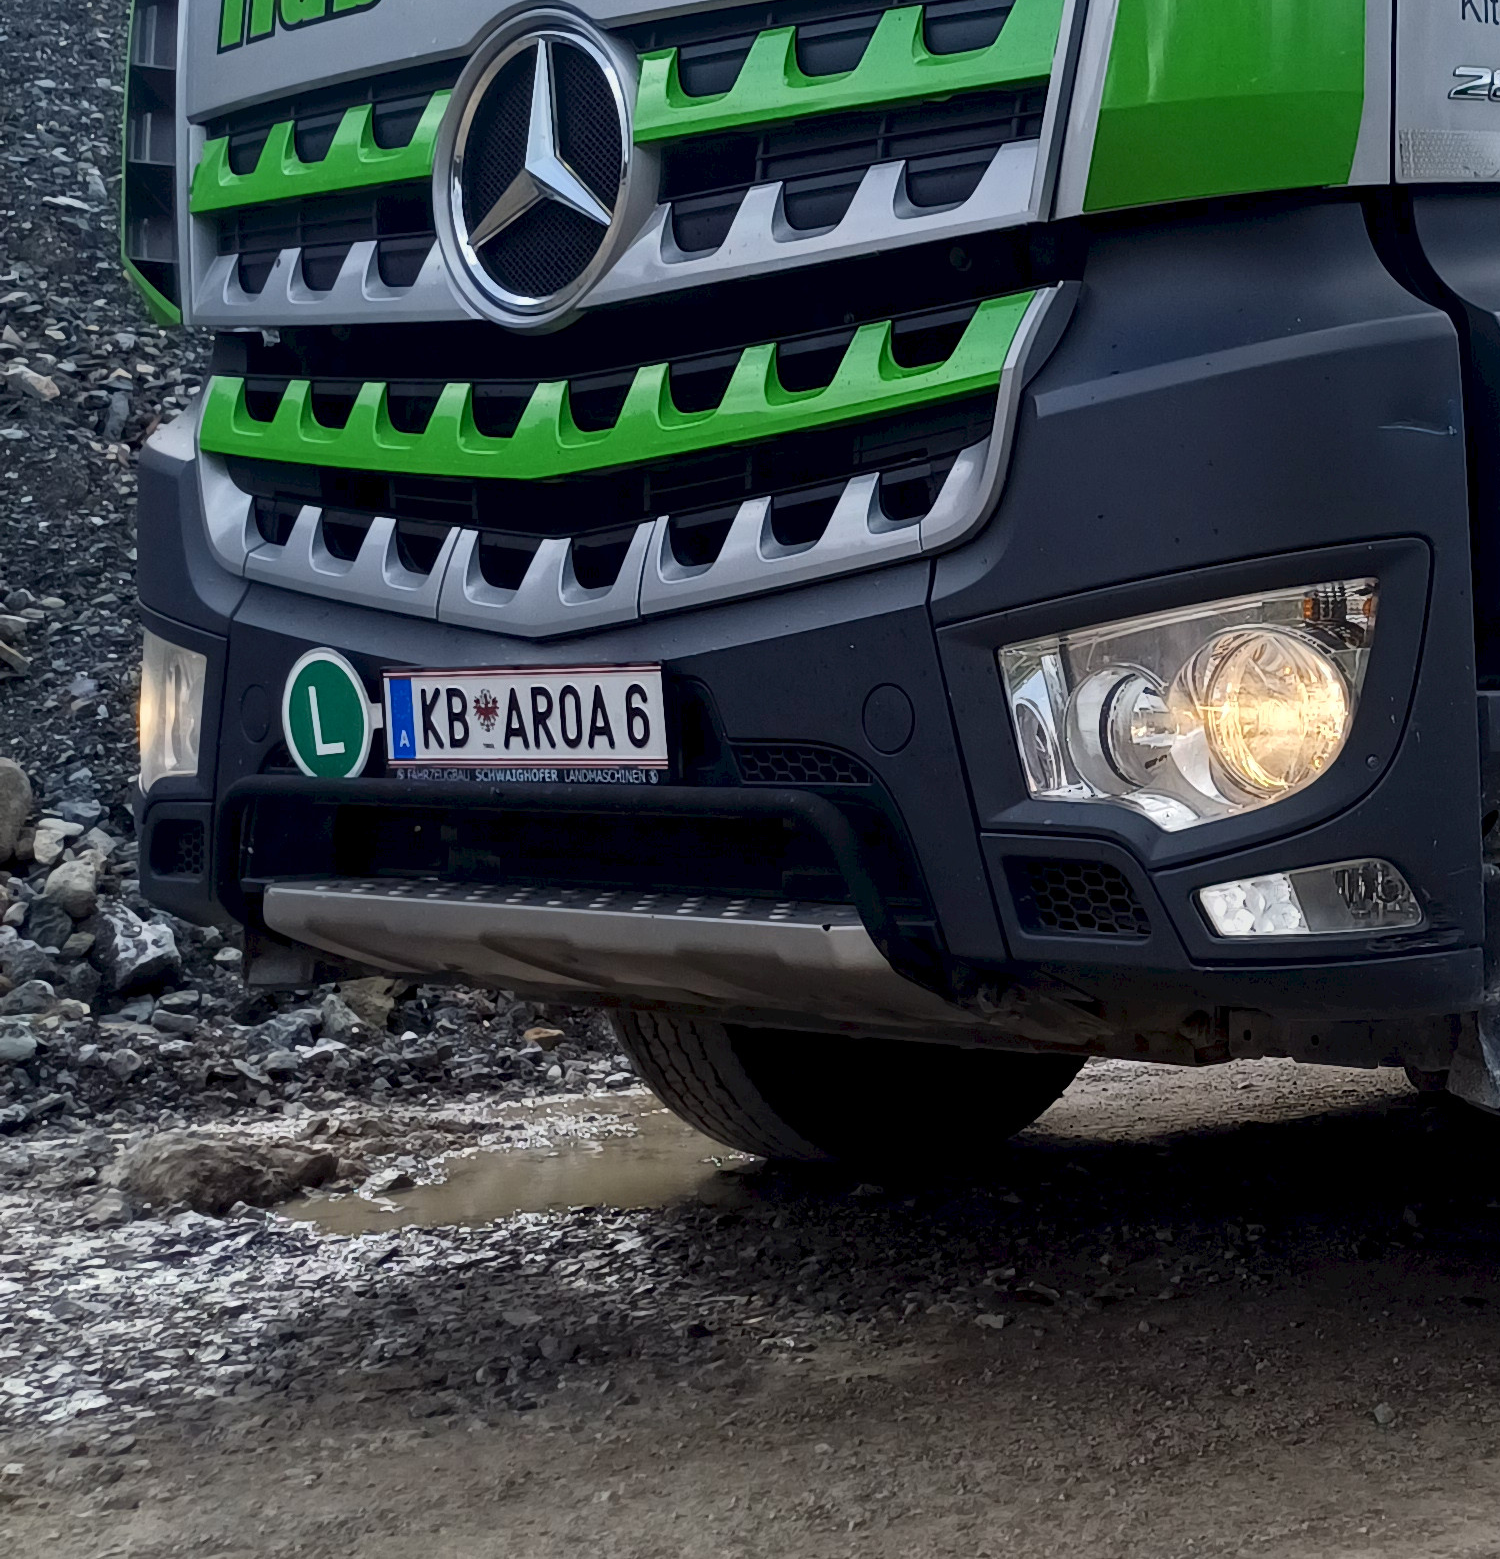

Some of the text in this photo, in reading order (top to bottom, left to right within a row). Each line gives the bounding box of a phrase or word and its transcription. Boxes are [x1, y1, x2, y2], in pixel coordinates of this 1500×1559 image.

[308, 685, 346, 756] L
[420, 683, 651, 750] KB AROA 6
[399, 730, 411, 749] A
[475, 769, 559, 783] SCHWAIGHOFER
[563, 769, 646, 783] LANDMASCHINEN
